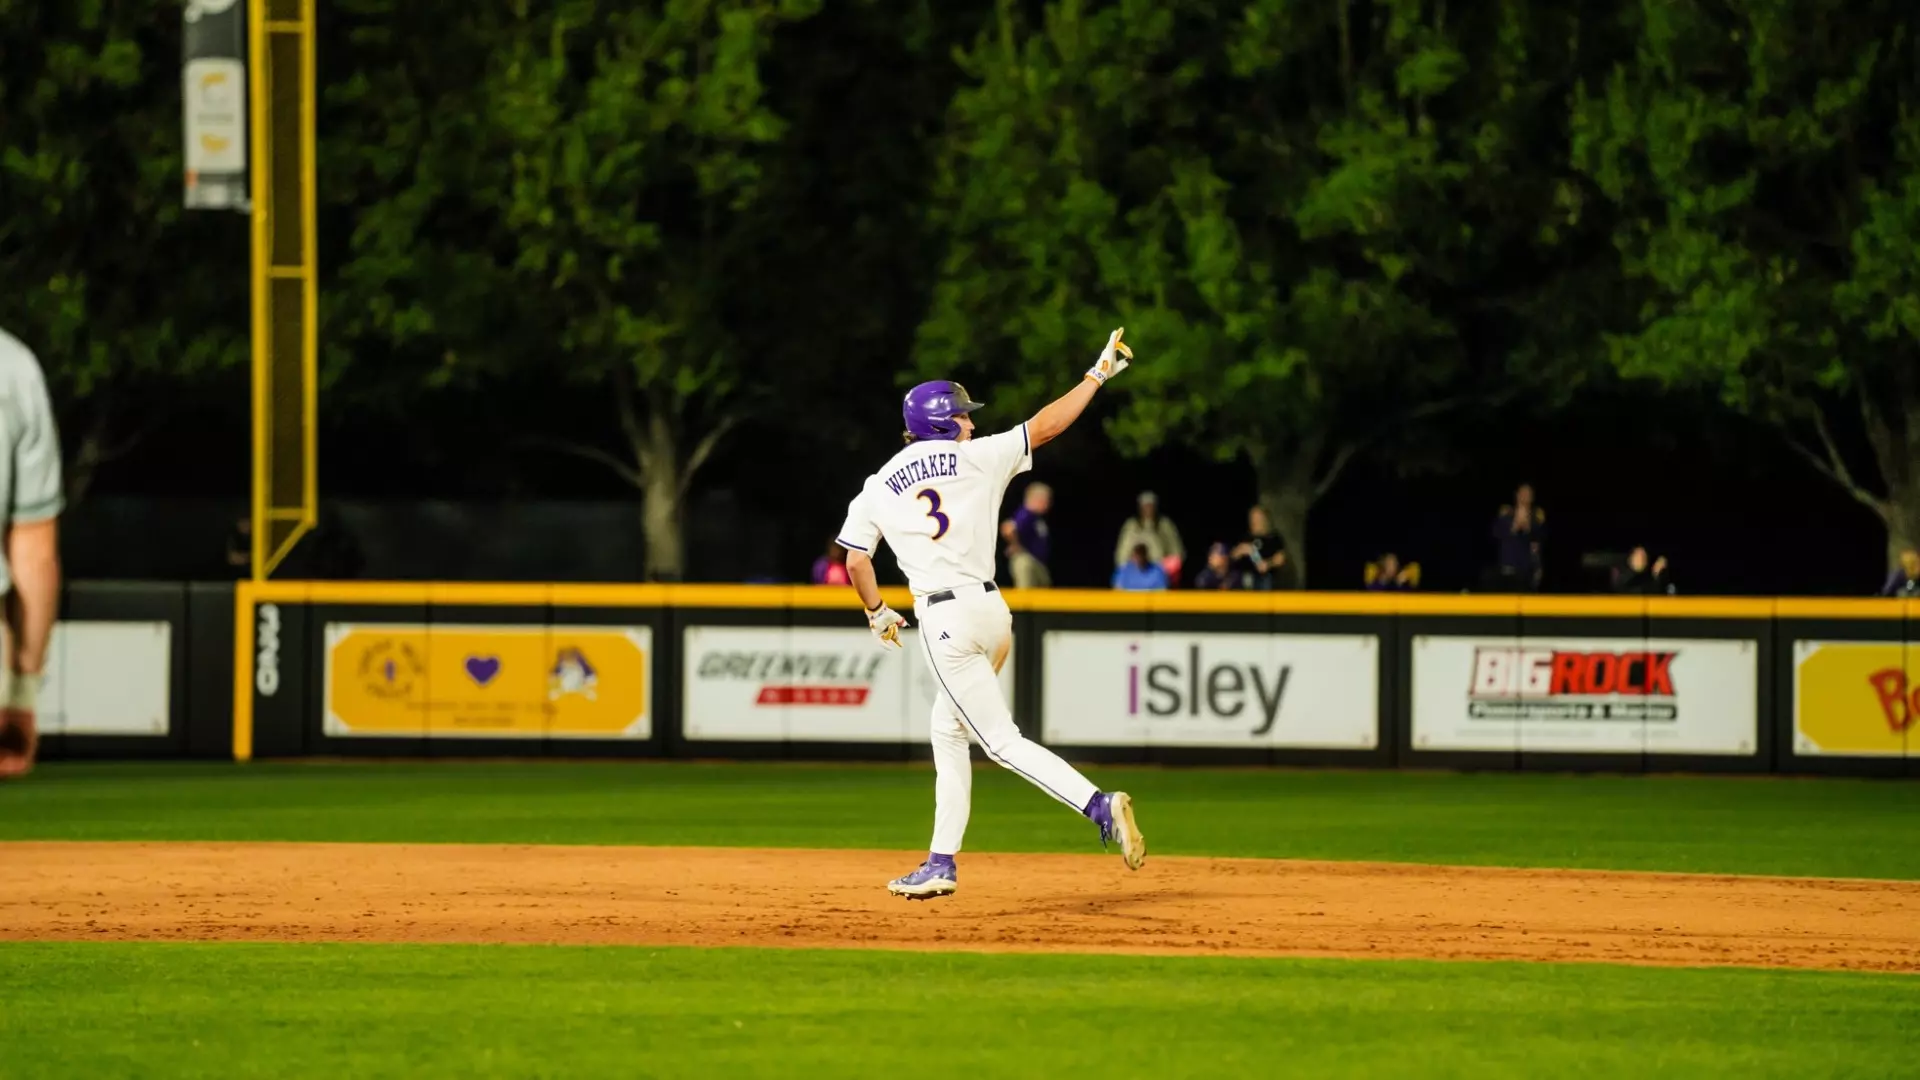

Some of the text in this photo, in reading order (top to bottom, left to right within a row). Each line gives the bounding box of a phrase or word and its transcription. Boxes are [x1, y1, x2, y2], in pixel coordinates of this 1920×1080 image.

[885, 453, 958, 496] WHITAKER
[916, 487, 951, 541] 3
[1128, 645, 1291, 735] isley
